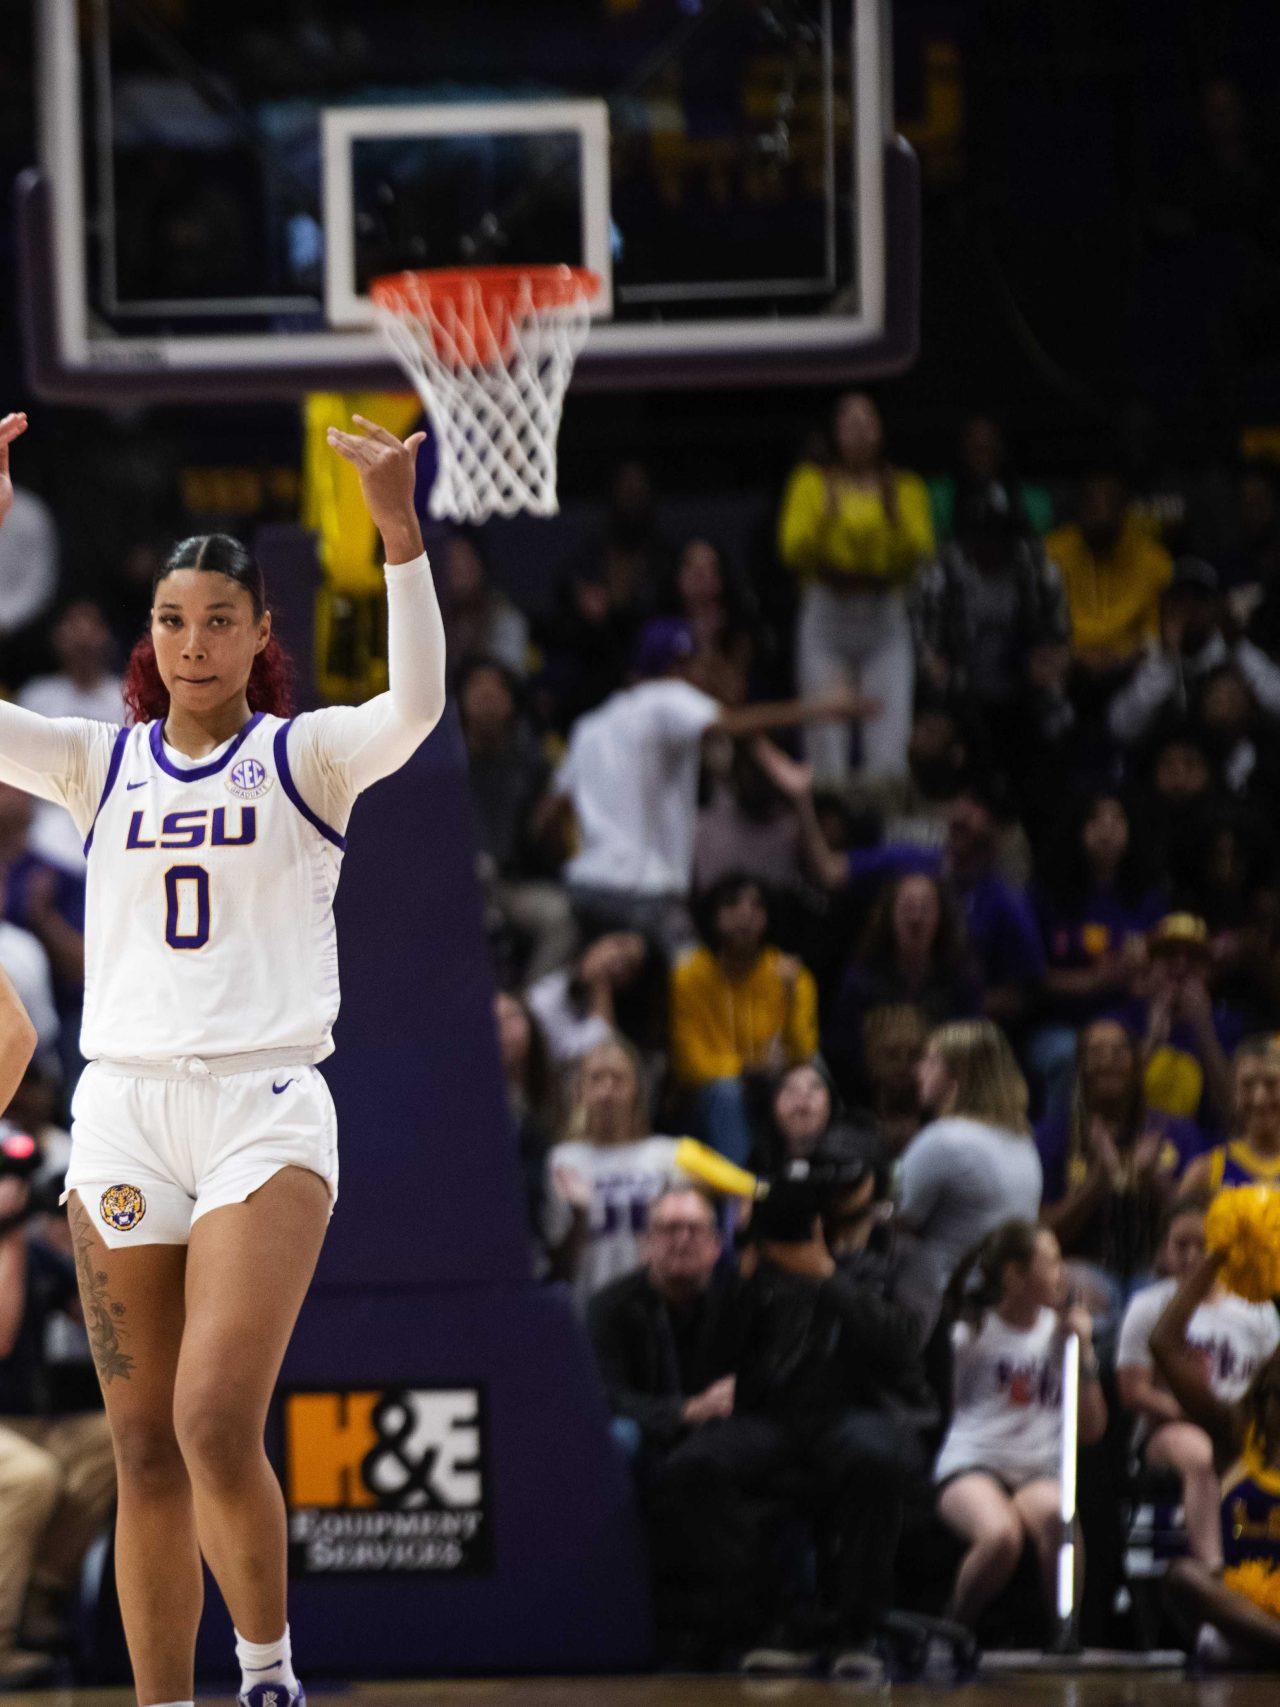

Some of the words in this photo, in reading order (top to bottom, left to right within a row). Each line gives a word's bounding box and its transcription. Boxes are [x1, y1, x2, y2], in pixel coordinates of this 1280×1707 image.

[231, 759, 265, 789] SEC
[125, 806, 257, 850] LSU
[163, 864, 211, 950] 0
[286, 1388, 481, 1507] H&E
